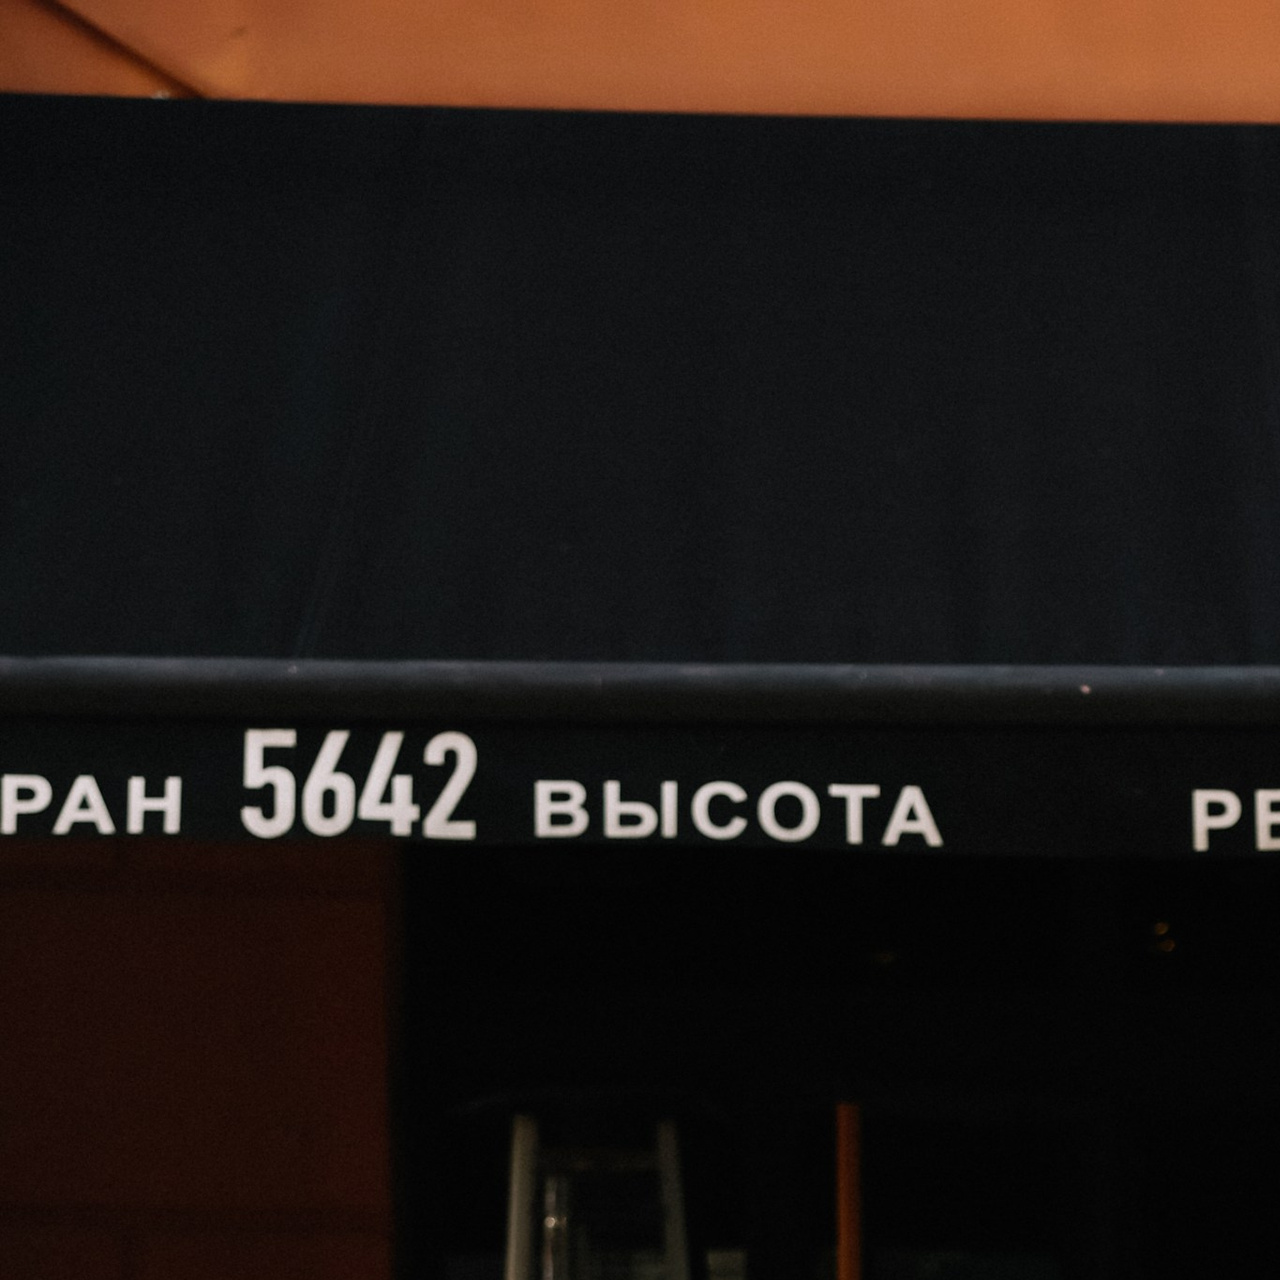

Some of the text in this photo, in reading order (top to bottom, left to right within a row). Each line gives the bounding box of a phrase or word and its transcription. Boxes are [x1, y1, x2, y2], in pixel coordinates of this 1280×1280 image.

[0, 729, 943, 847] РАН 5642 ВЫСОТА
